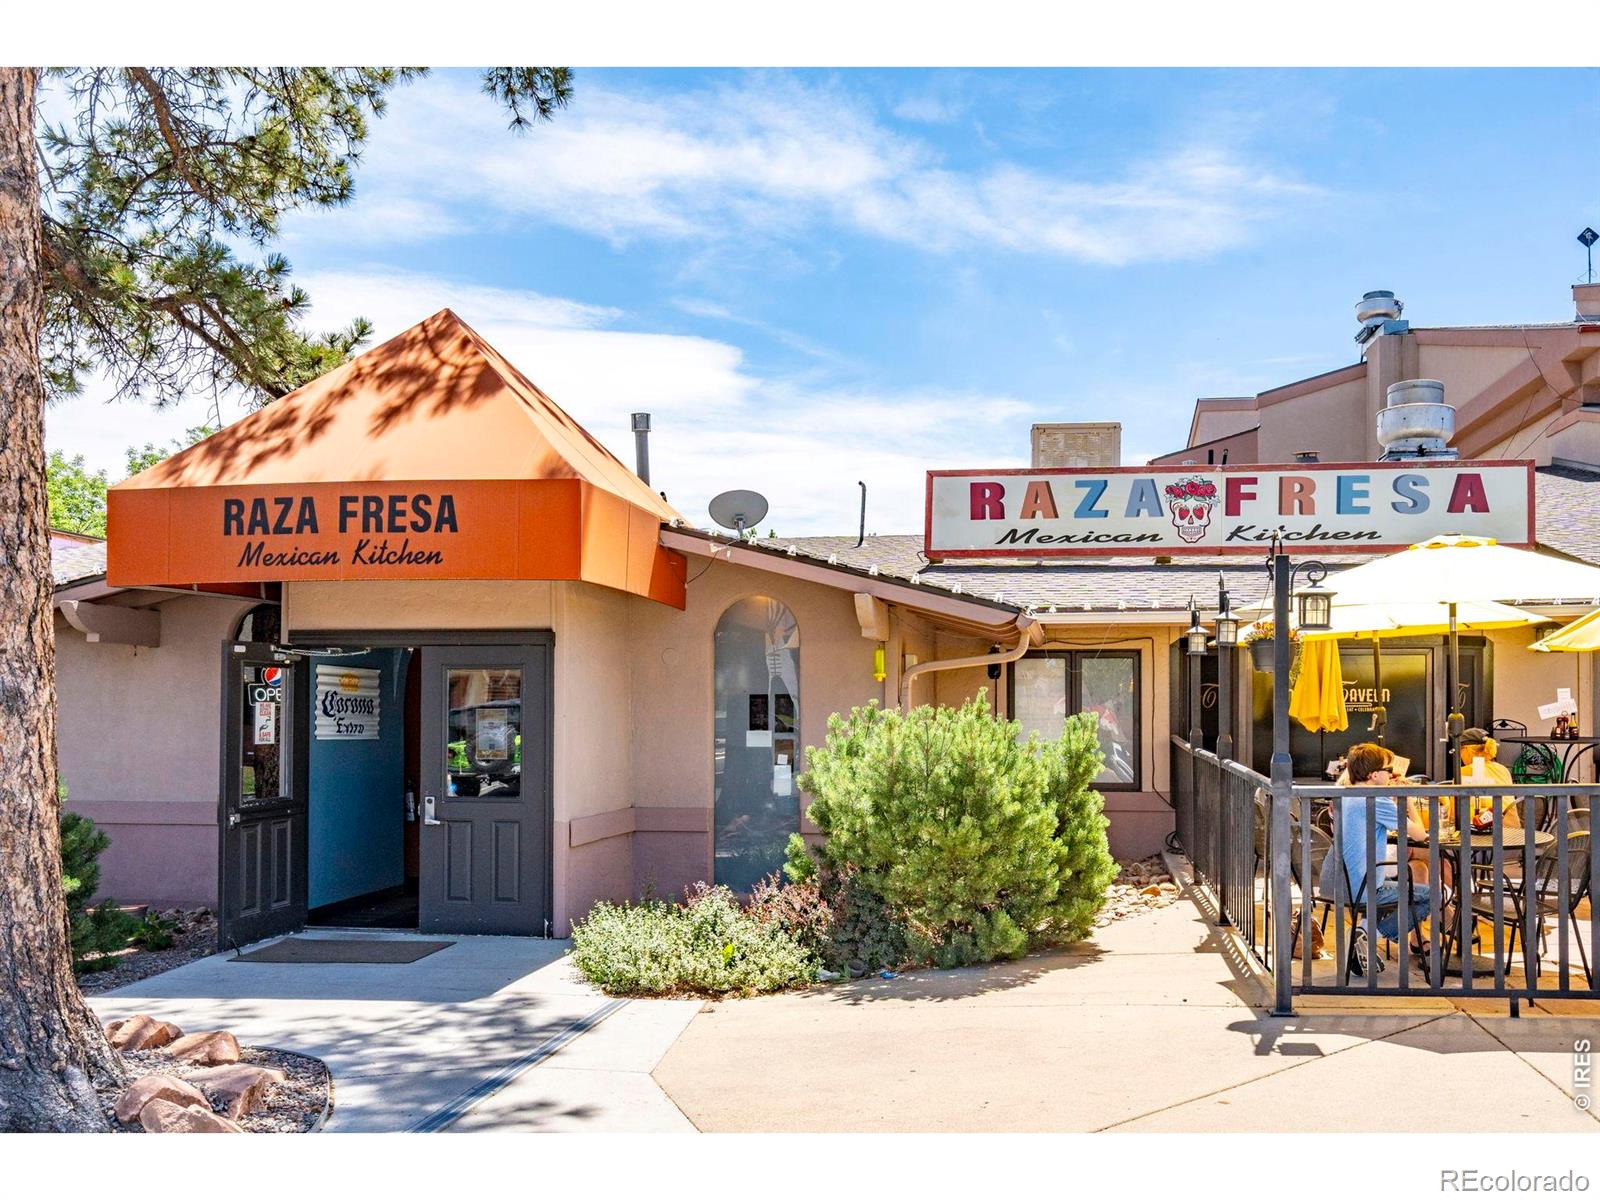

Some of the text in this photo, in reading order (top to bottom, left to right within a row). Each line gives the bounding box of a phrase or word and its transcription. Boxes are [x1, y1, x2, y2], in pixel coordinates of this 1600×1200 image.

[970, 473, 1491, 521] RAZA FRESA
[223, 494, 459, 536] RAZA FRESA
[995, 527, 1164, 545] Mexican
[237, 538, 444, 568] Mexican Kitchen
[255, 687, 282, 702] OPE
[322, 690, 375, 718] Corona
